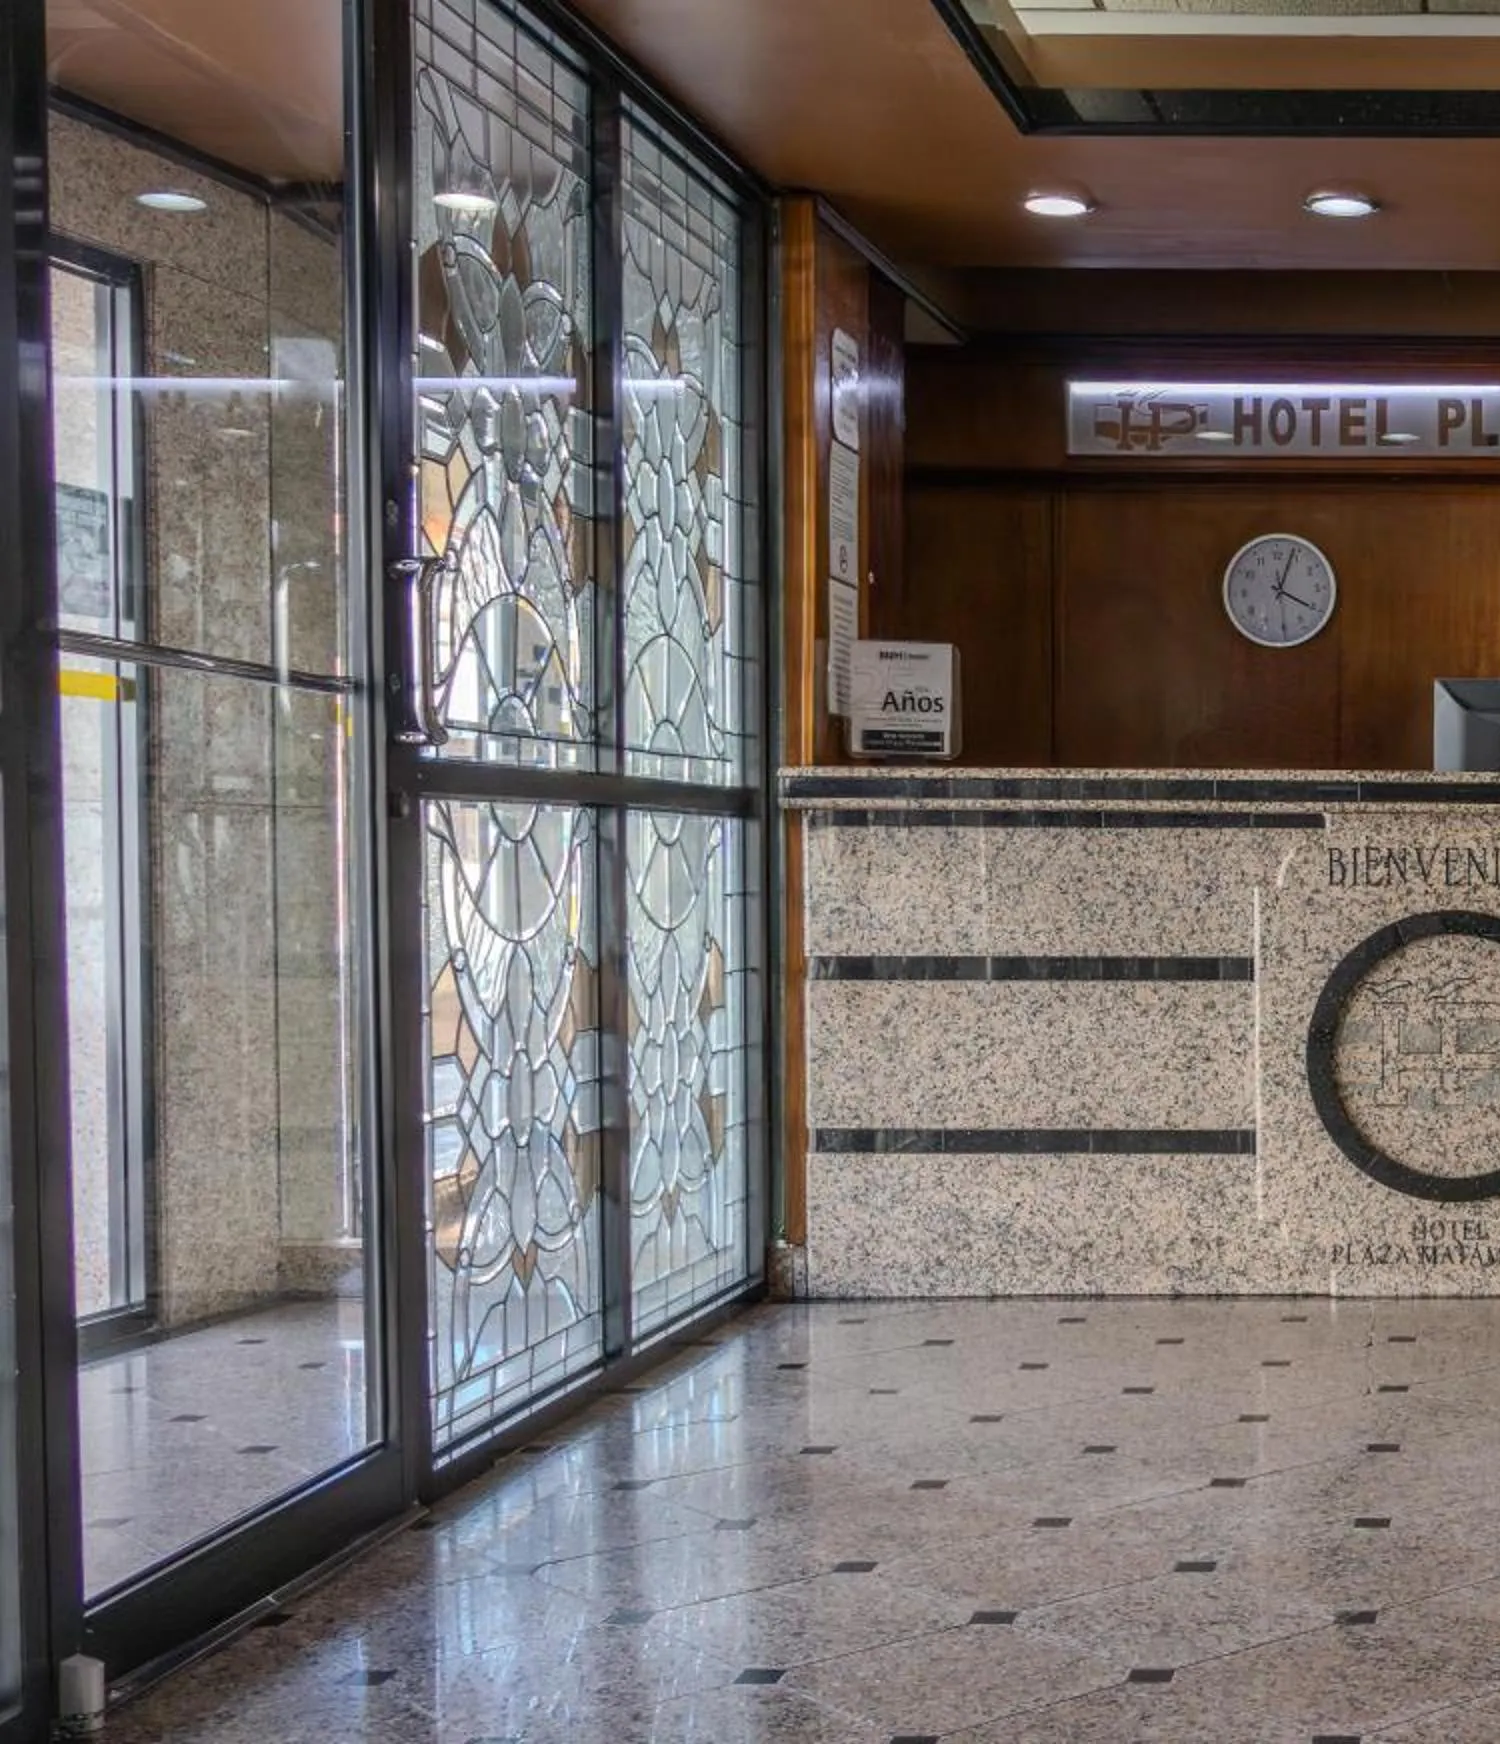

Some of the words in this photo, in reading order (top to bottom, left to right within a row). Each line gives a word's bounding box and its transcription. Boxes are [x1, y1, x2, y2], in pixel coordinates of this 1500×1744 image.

[1233, 397, 1404, 446] HOTEL
[881, 689, 945, 713] Años
[1410, 1217, 1490, 1242] HOTEL
[1331, 1244, 1409, 1266] PLAZA
